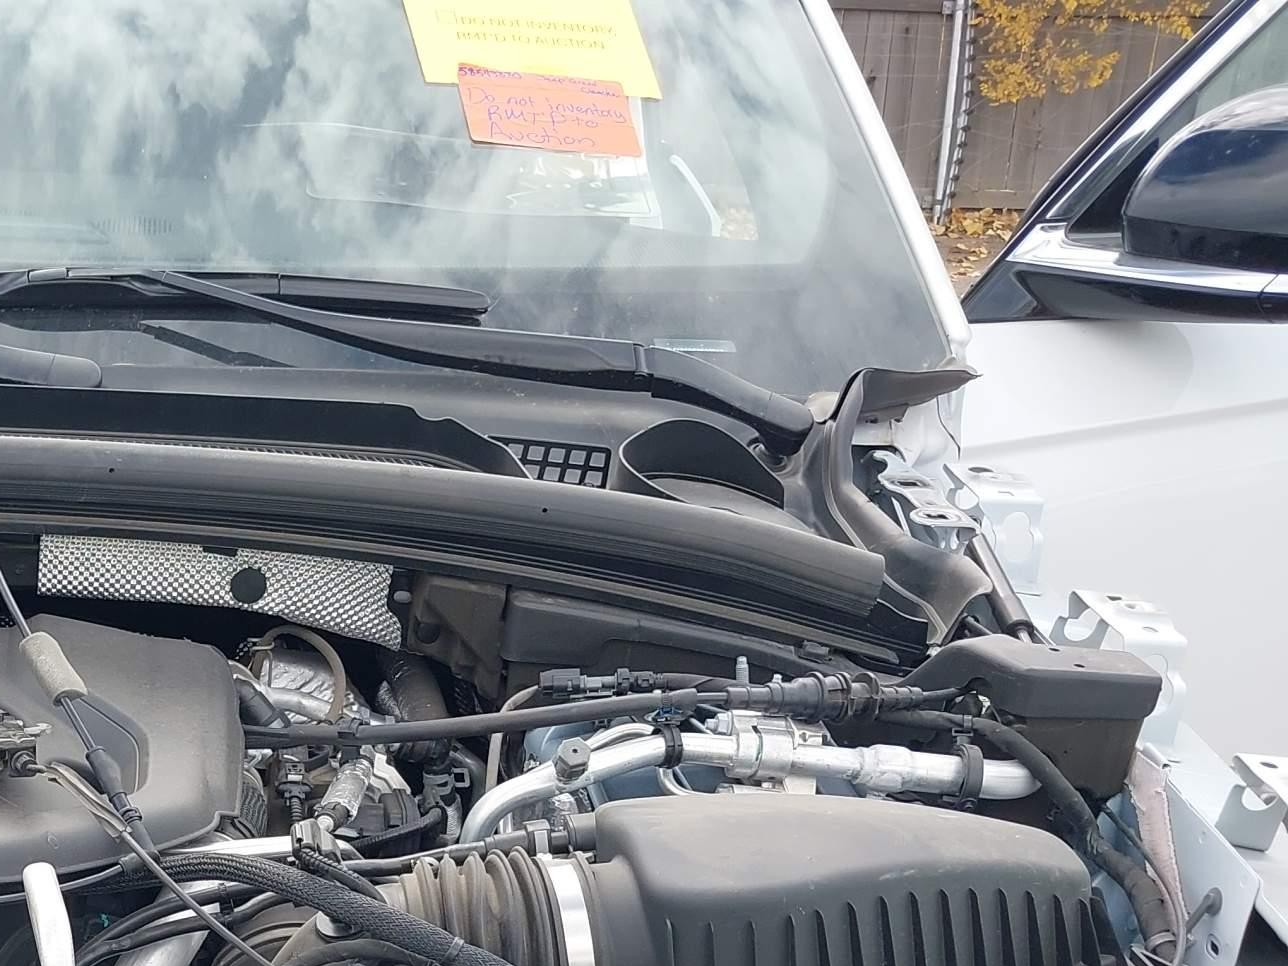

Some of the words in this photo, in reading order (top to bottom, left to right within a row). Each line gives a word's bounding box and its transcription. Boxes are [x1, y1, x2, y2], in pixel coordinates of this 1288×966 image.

[467, 87, 496, 105] Do
[507, 97, 536, 106] not
[546, 97, 627, 123] inventory
[490, 121, 596, 147] Auction
[571, 116, 600, 129] to
